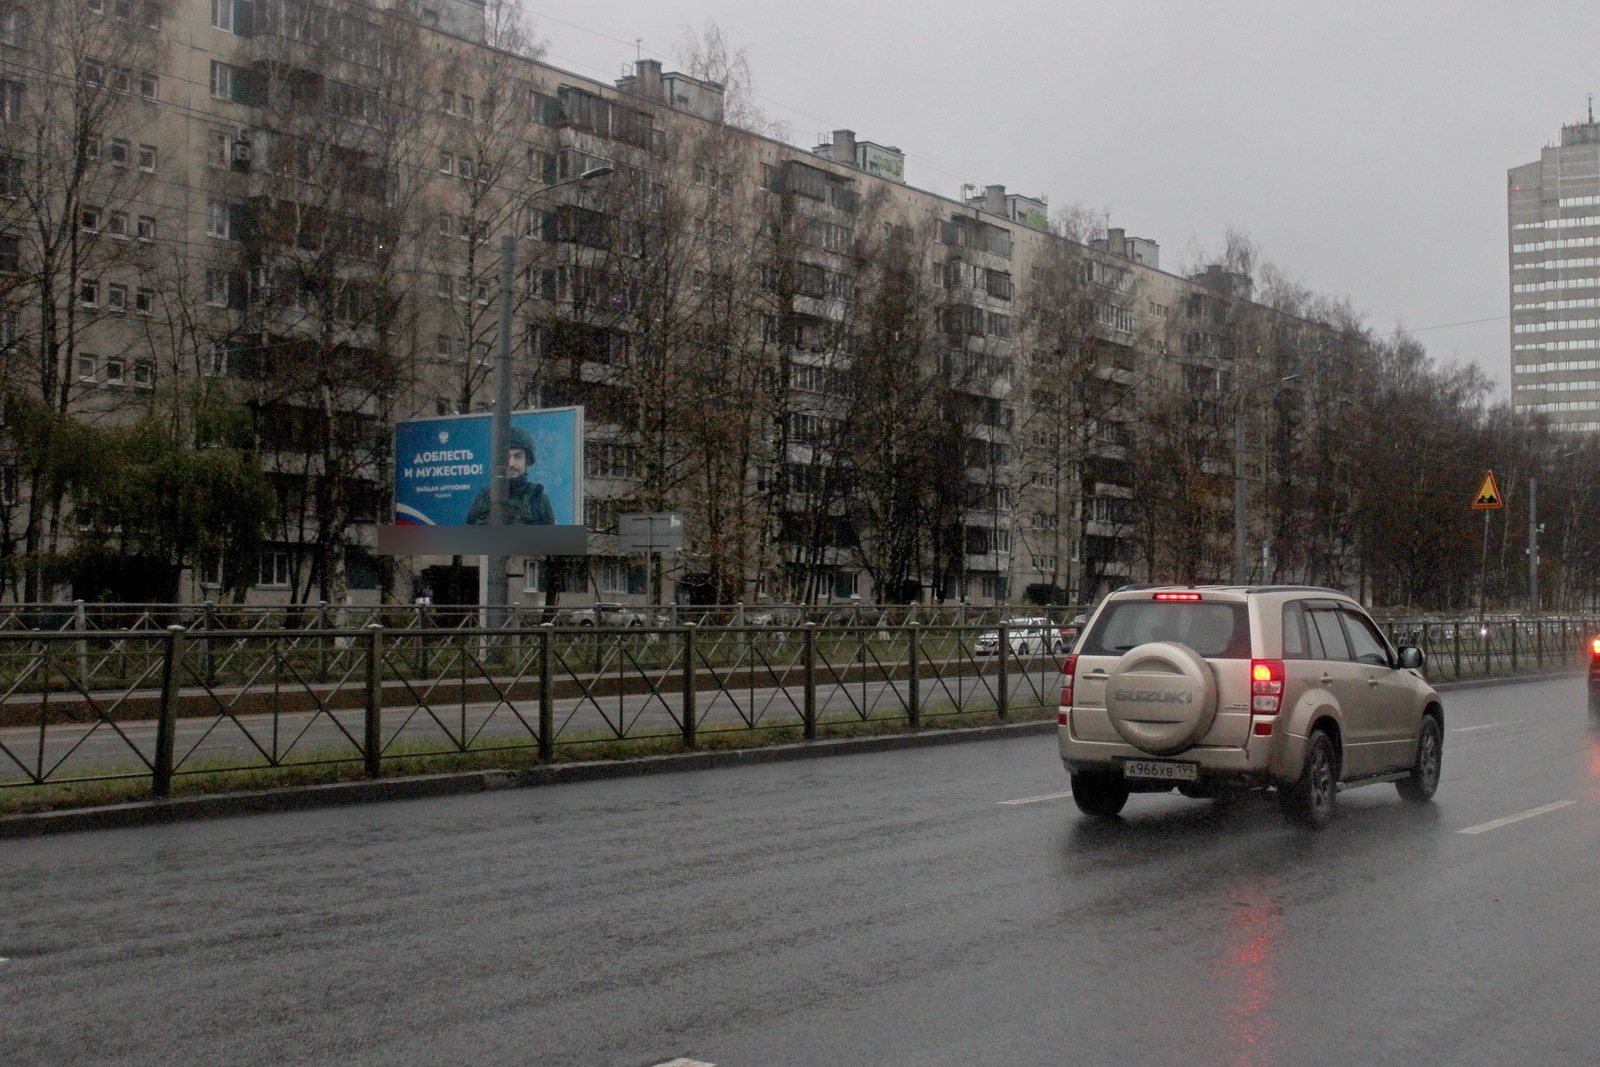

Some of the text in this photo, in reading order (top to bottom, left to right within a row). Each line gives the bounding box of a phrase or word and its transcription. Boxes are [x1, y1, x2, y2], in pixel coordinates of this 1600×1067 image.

[414, 450, 473, 463] ДОБЛЕСТЬ
[404, 464, 483, 478] И МУЖЕСТВО!
[1115, 687, 1193, 704] SUZUKI
